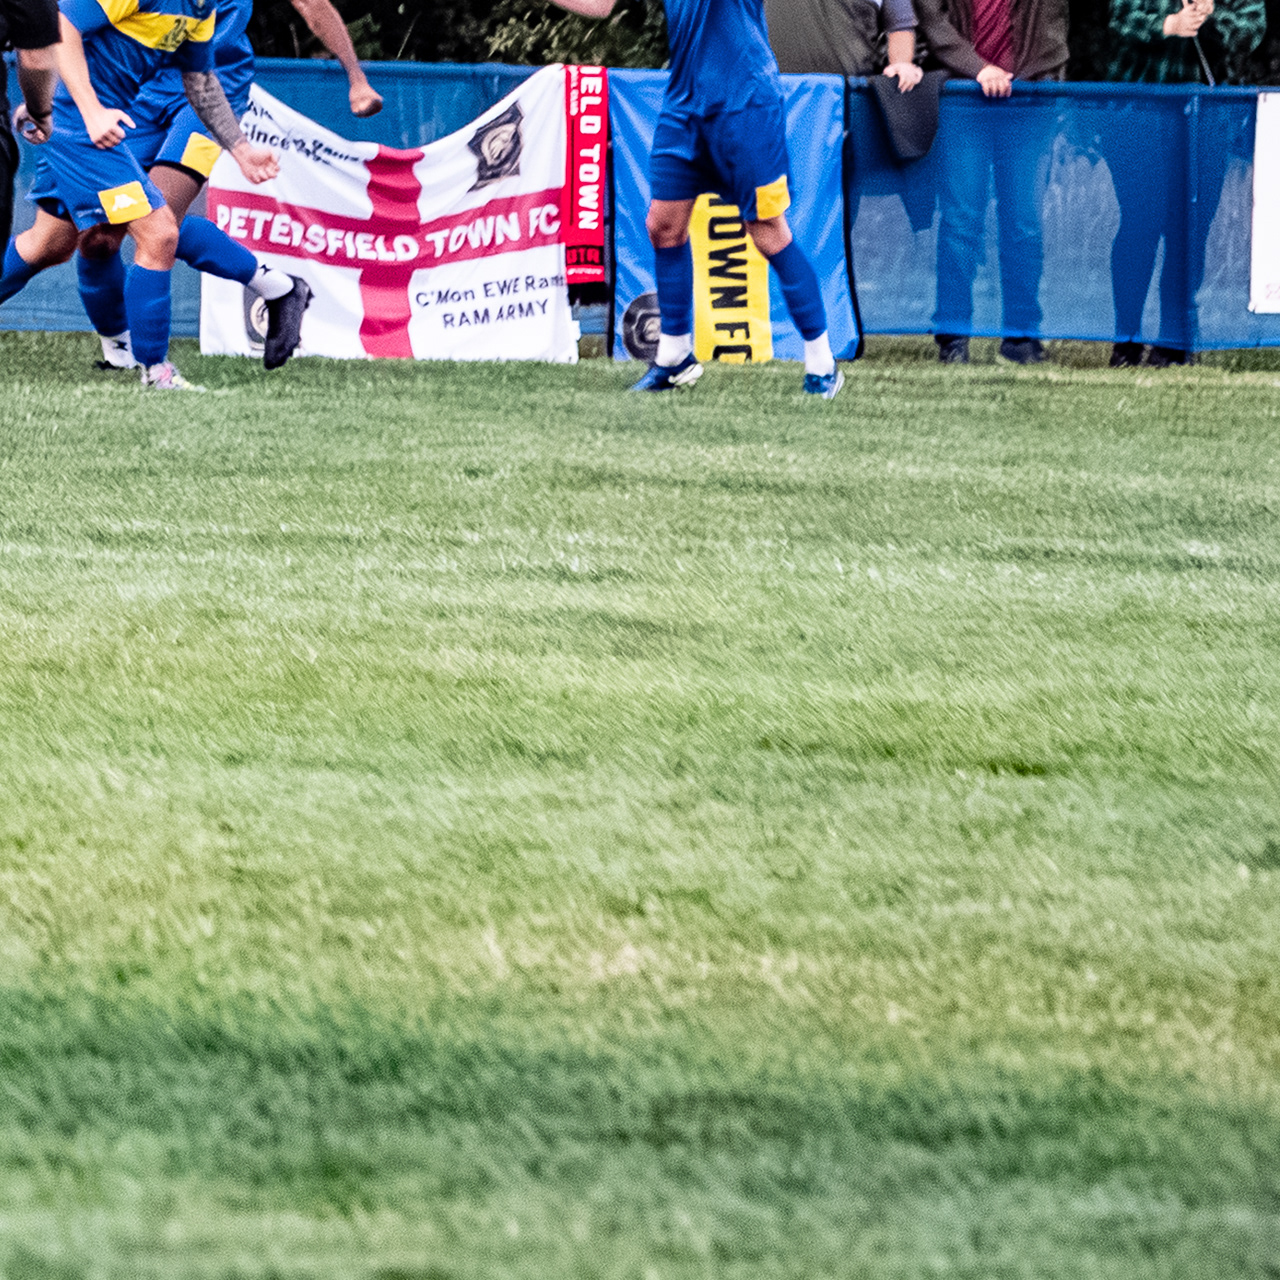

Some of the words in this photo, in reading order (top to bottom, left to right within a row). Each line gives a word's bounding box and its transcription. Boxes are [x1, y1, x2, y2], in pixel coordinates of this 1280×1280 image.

[577, 143, 601, 230] TOWN
[216, 203, 421, 262] PETERSFIELD
[424, 211, 522, 258] TOWN
[528, 203, 562, 239] FC
[483, 277, 520, 298] EWE
[442, 307, 491, 329] RAM
[496, 298, 549, 322] ARMY
